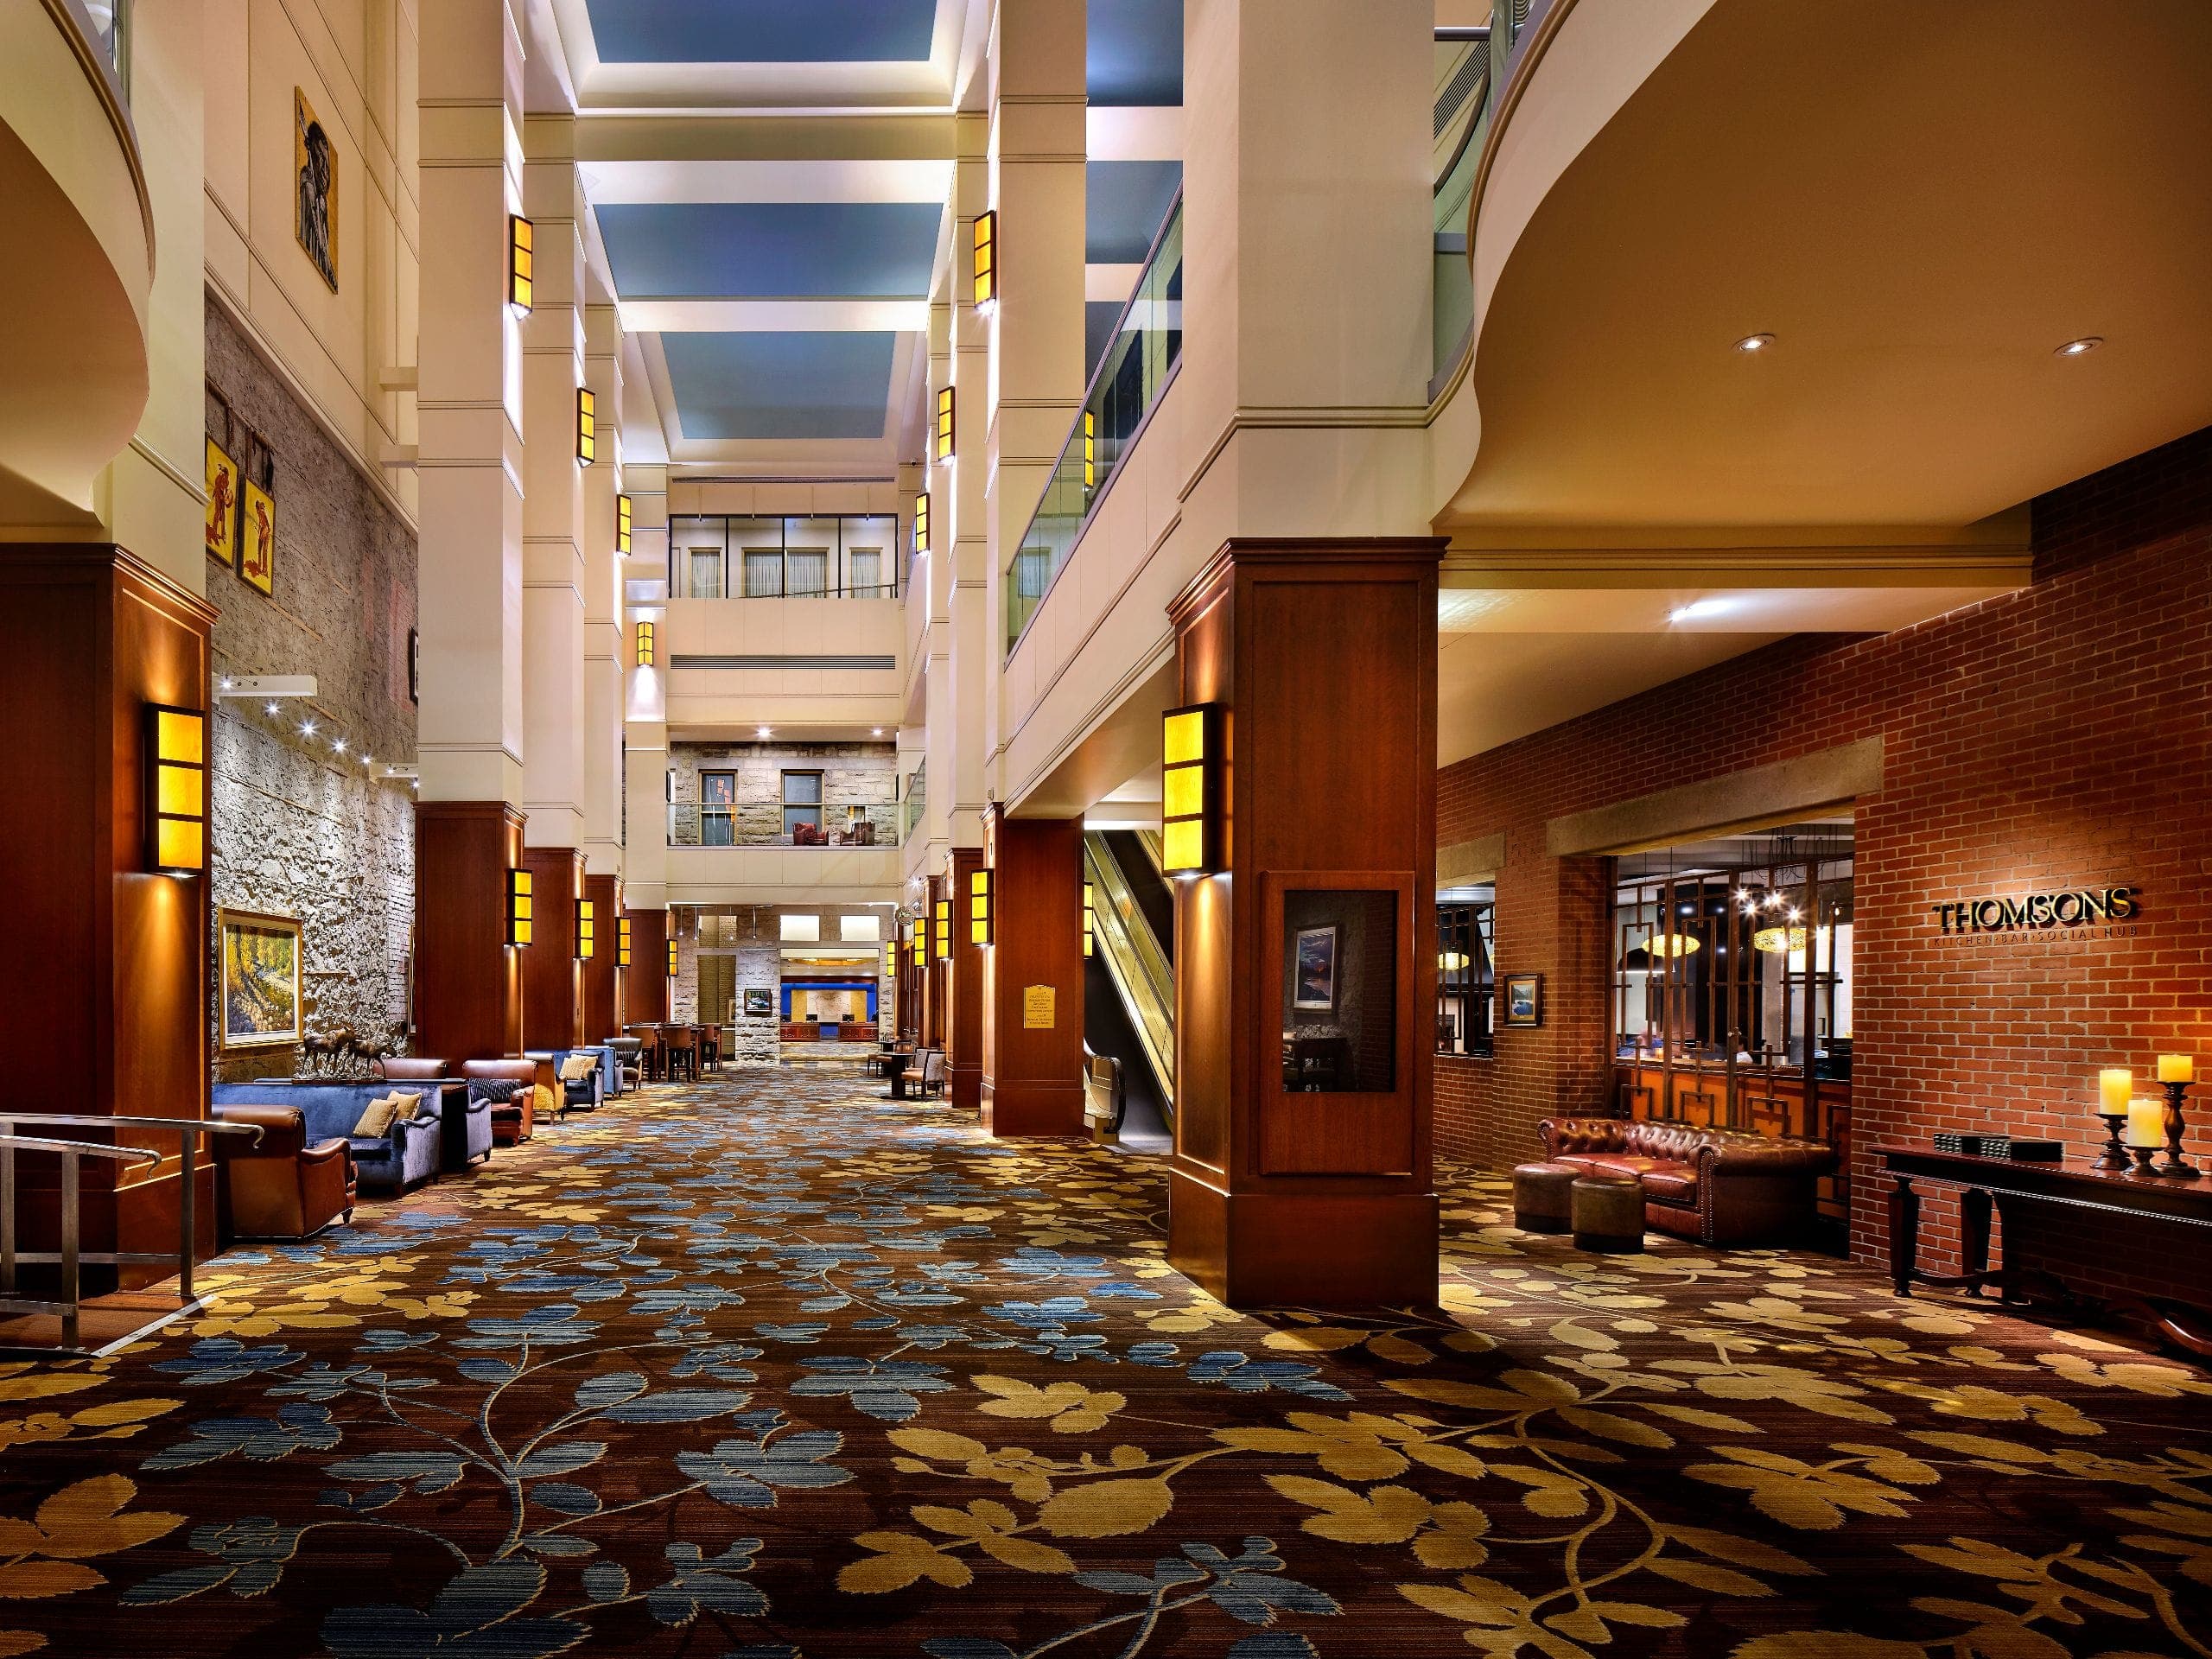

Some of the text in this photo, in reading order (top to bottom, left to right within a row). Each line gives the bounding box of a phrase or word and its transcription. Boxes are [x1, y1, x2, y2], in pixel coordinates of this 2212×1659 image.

[1932, 887, 2132, 930] THOMSONS
[2001, 932, 2029, 944] BAR
[2037, 928, 2097, 941] SOCIAL
[2105, 925, 2138, 938] HUB
